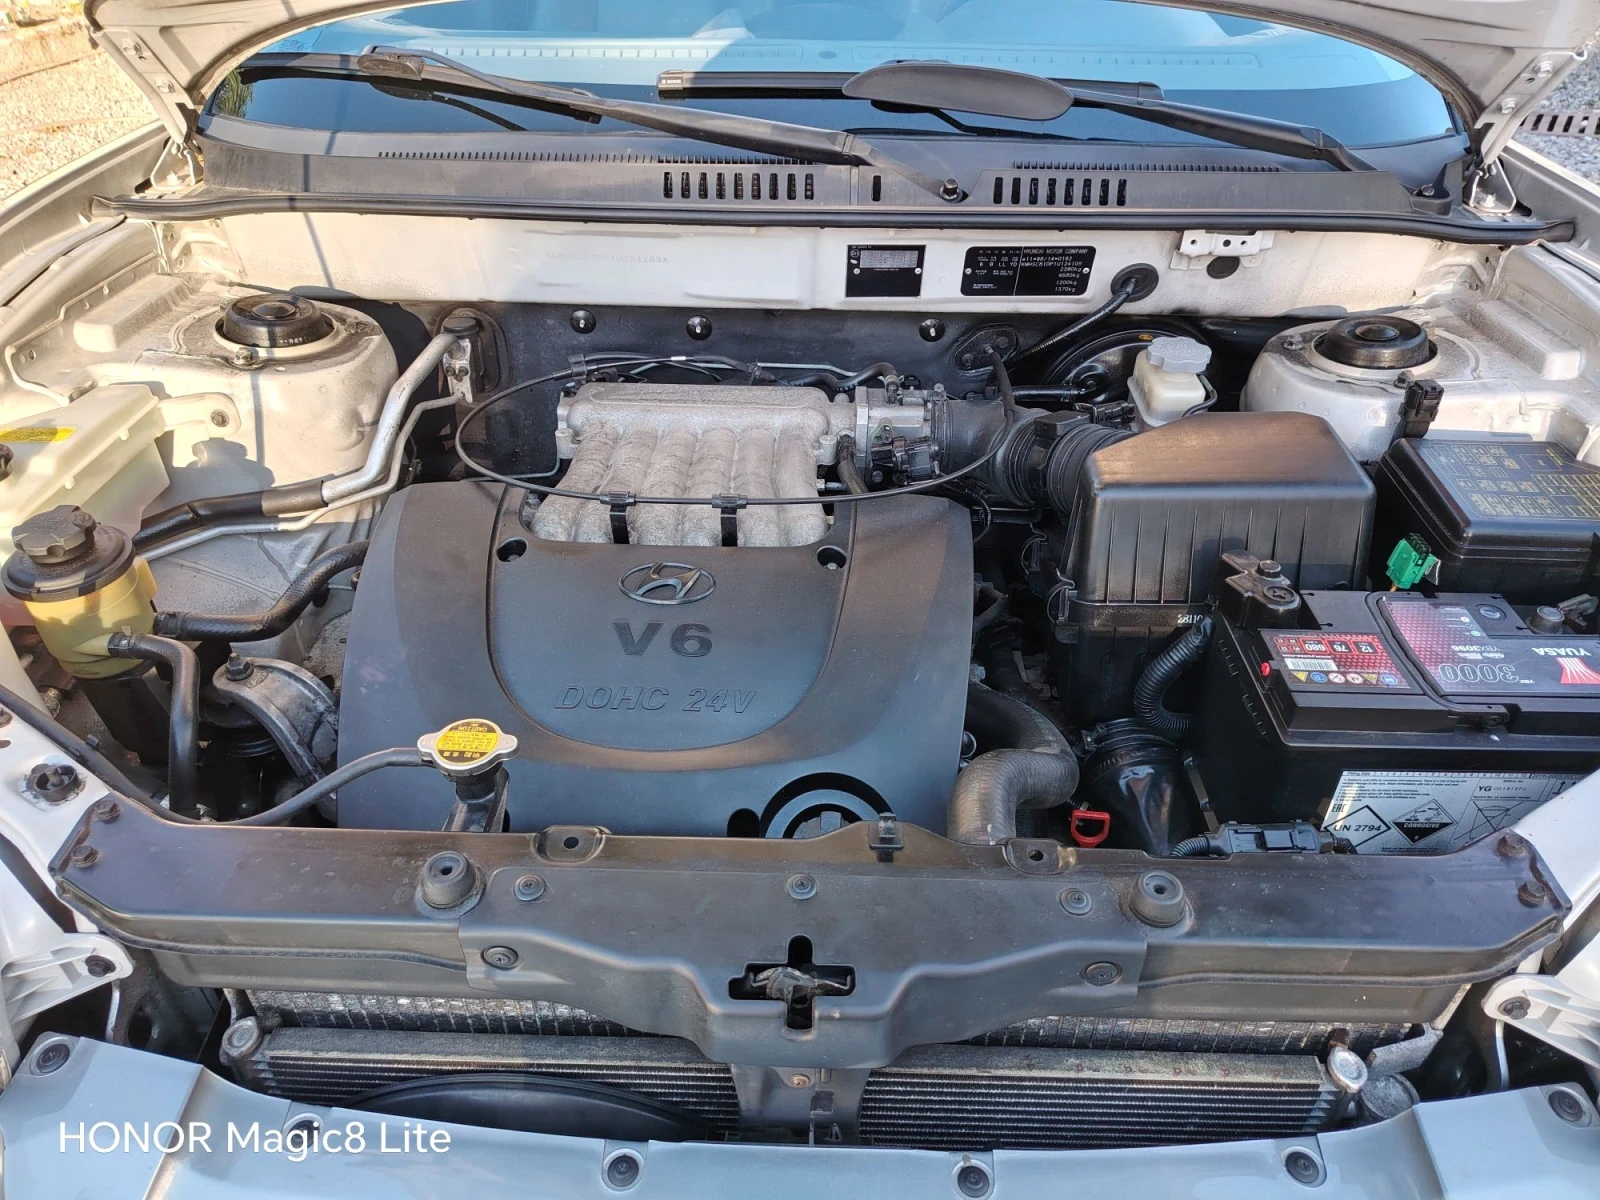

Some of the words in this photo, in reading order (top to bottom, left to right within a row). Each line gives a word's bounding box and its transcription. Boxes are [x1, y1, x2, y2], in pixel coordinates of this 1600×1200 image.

[612, 618, 713, 657] V6
[1305, 643, 1326, 652] 680
[1333, 644, 1349, 652] 76
[1360, 645, 1374, 653] 12
[1531, 647, 1592, 656] YUASA
[1439, 663, 1519, 683] 3000
[554, 684, 669, 711] DOHC
[682, 688, 758, 713] 24V
[1333, 824, 1351, 832] UN
[1353, 824, 1382, 832] 2794
